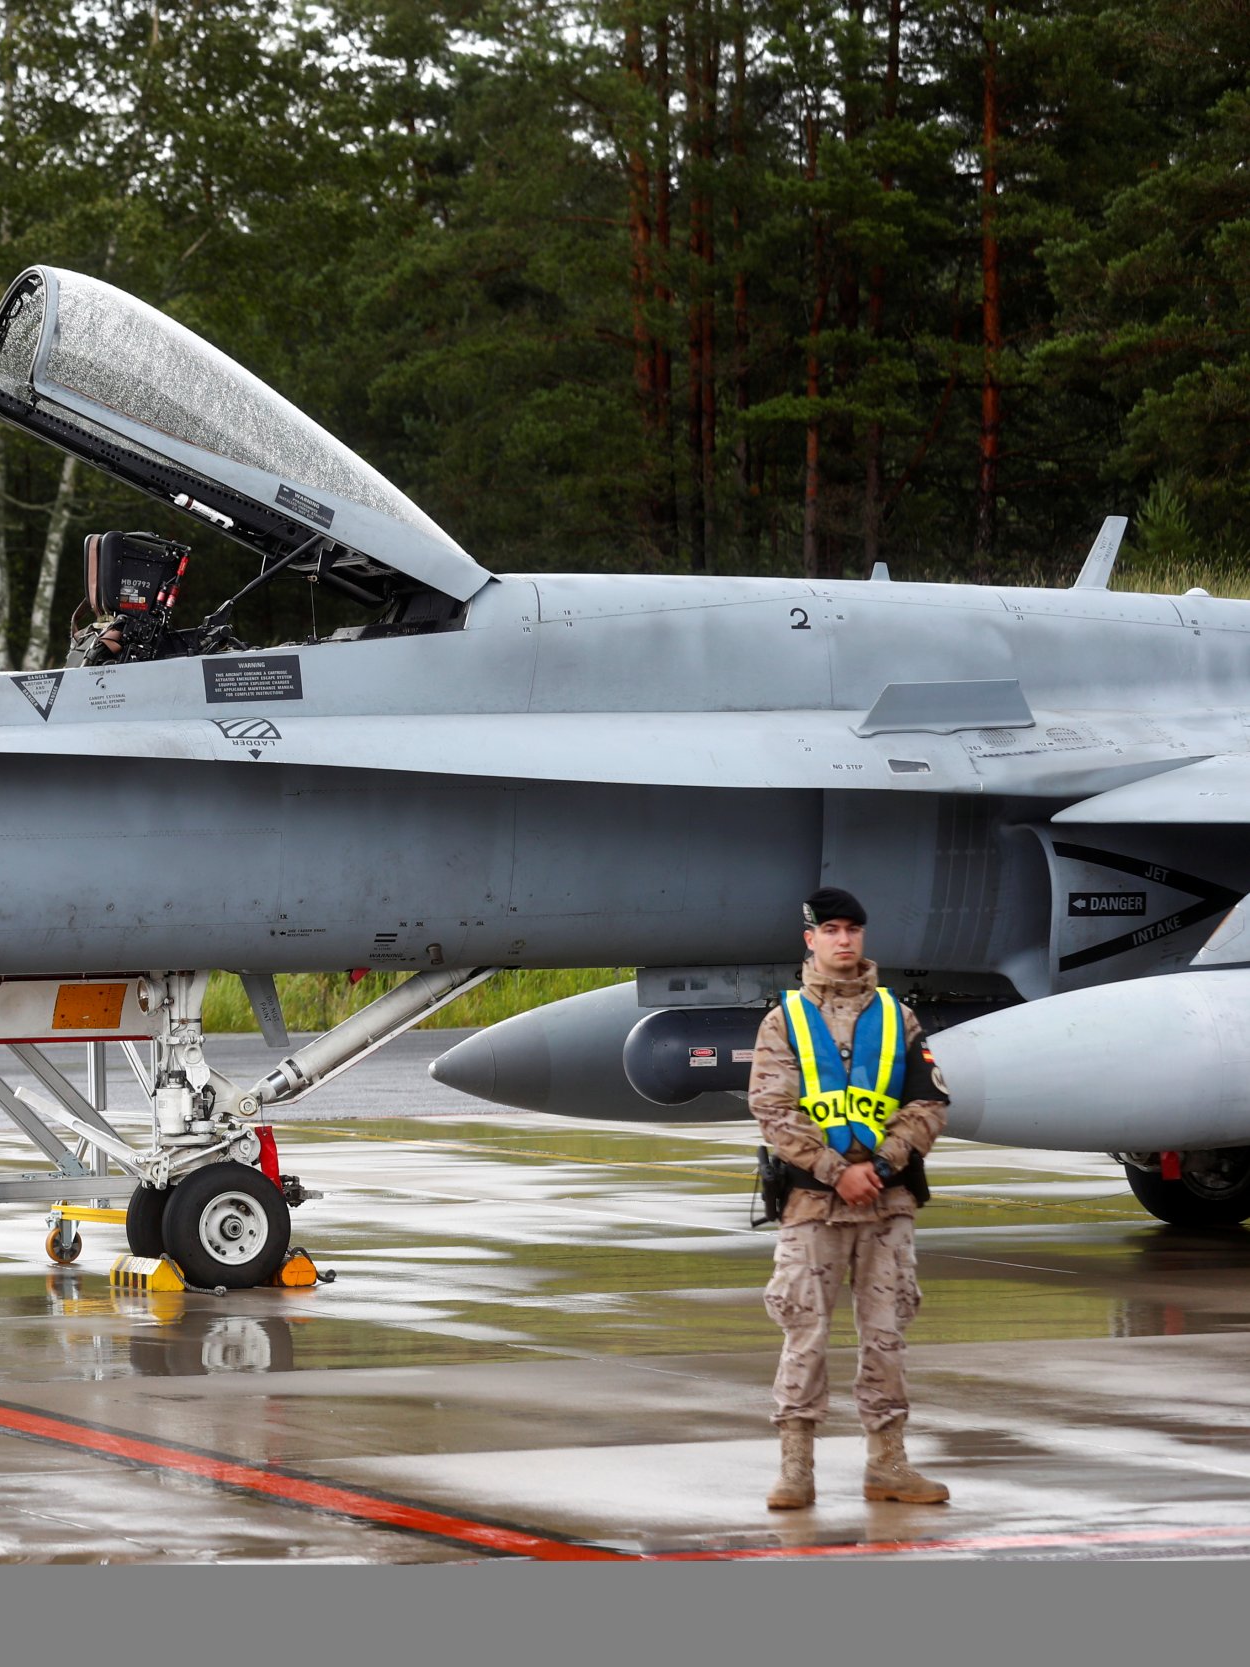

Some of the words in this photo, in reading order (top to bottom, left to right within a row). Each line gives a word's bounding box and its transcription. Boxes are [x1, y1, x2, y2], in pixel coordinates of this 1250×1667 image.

[294, 492, 320, 509] WARNING
[238, 661, 266, 669] WARNING
[27, 673, 48, 681] DANGER
[232, 739, 276, 747] LADDER
[1144, 865, 1169, 882] JET
[1090, 896, 1143, 911] DANGER
[1132, 915, 1182, 946] INTAKE
